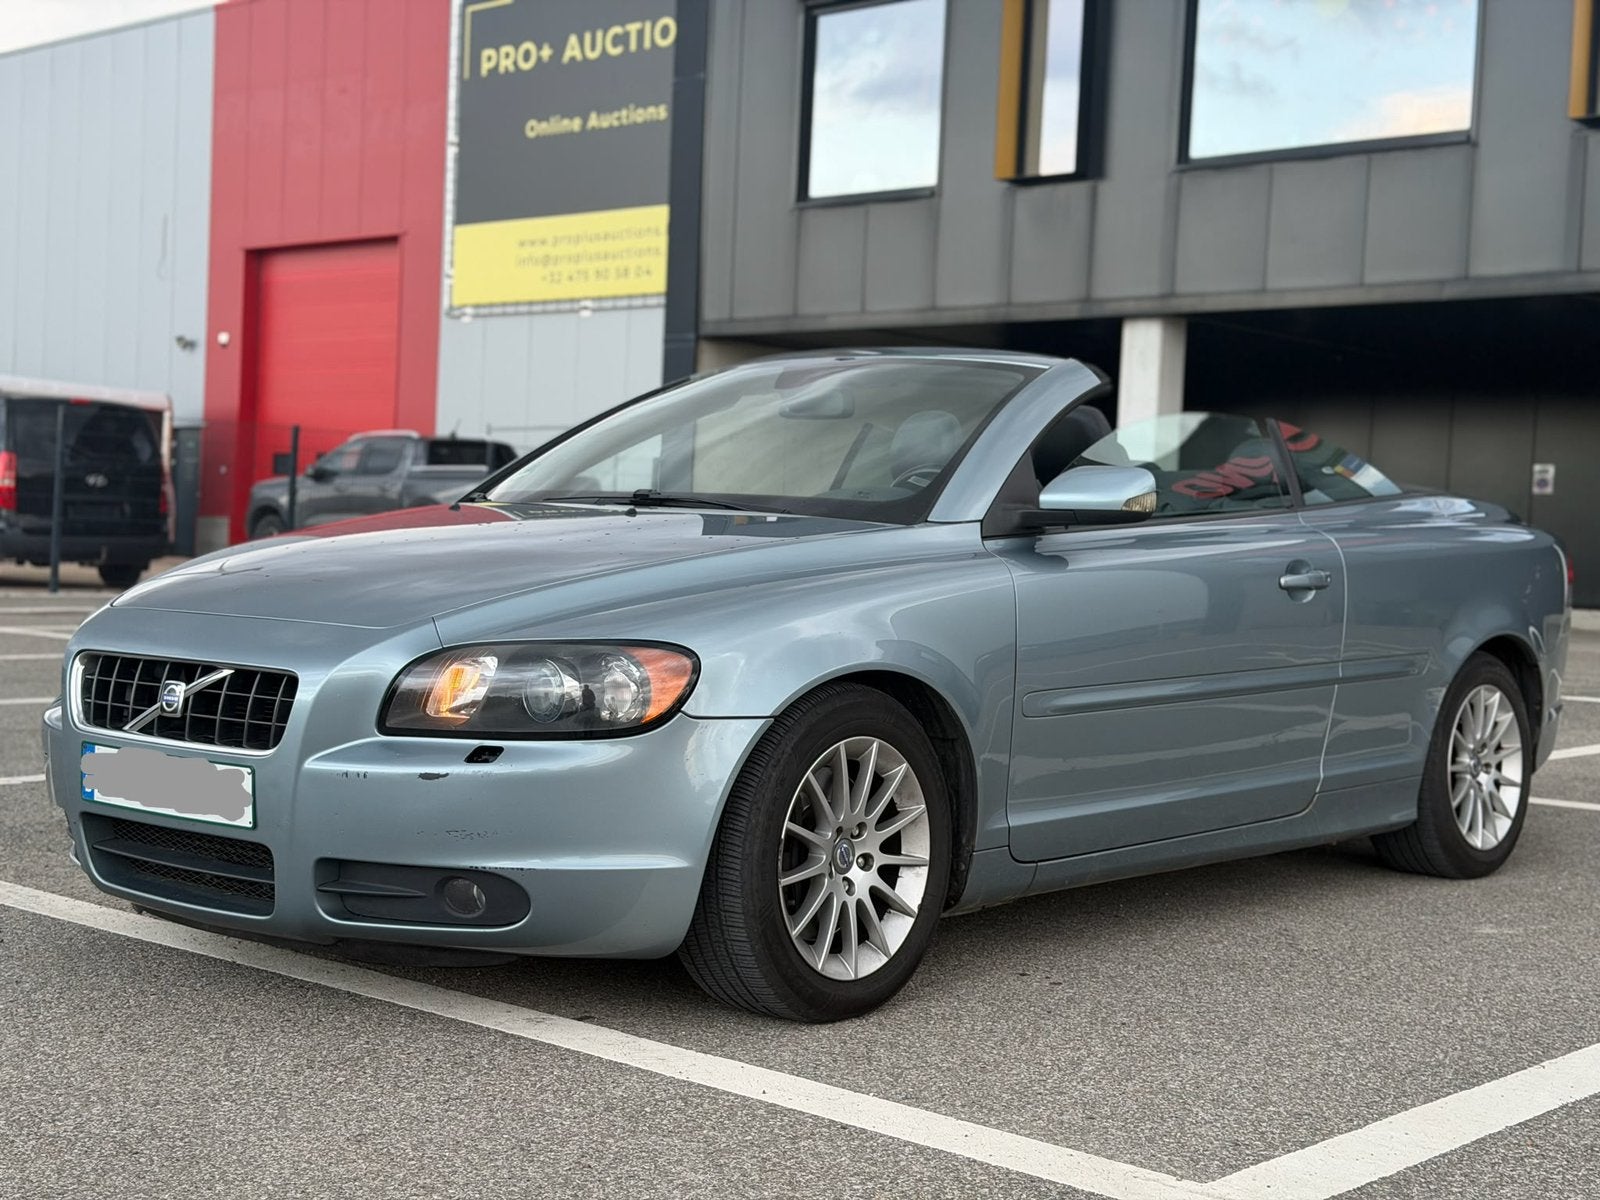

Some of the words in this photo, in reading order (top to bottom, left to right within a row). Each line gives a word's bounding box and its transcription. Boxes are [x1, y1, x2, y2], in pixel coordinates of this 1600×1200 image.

[480, 41, 553, 77] PRO+
[525, 116, 582, 138] Online
[586, 103, 668, 130] Auctions
